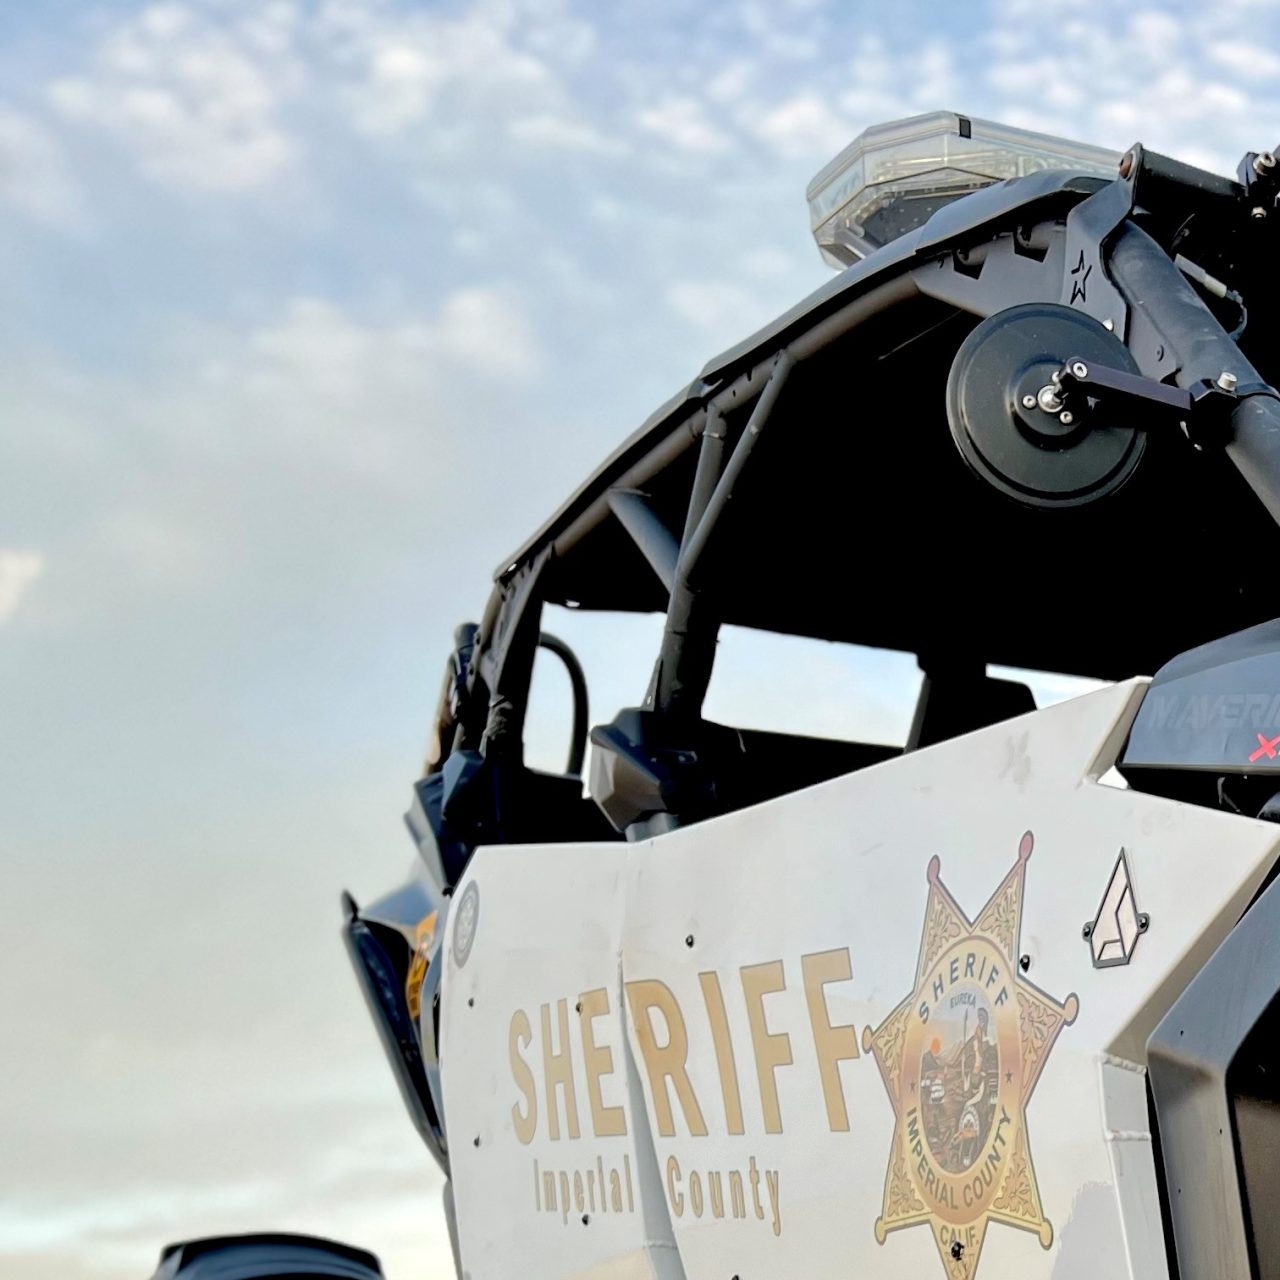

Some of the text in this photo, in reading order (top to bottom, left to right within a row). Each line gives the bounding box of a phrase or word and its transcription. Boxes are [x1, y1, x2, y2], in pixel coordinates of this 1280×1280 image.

[919, 952, 1009, 1025] SHERIFF
[950, 991, 976, 1009] EUREKA
[508, 946, 861, 1145] SHERIFF
[533, 1154, 782, 1237] Imperial County
[906, 1104, 1012, 1210] IMPERIAL COUNTY
